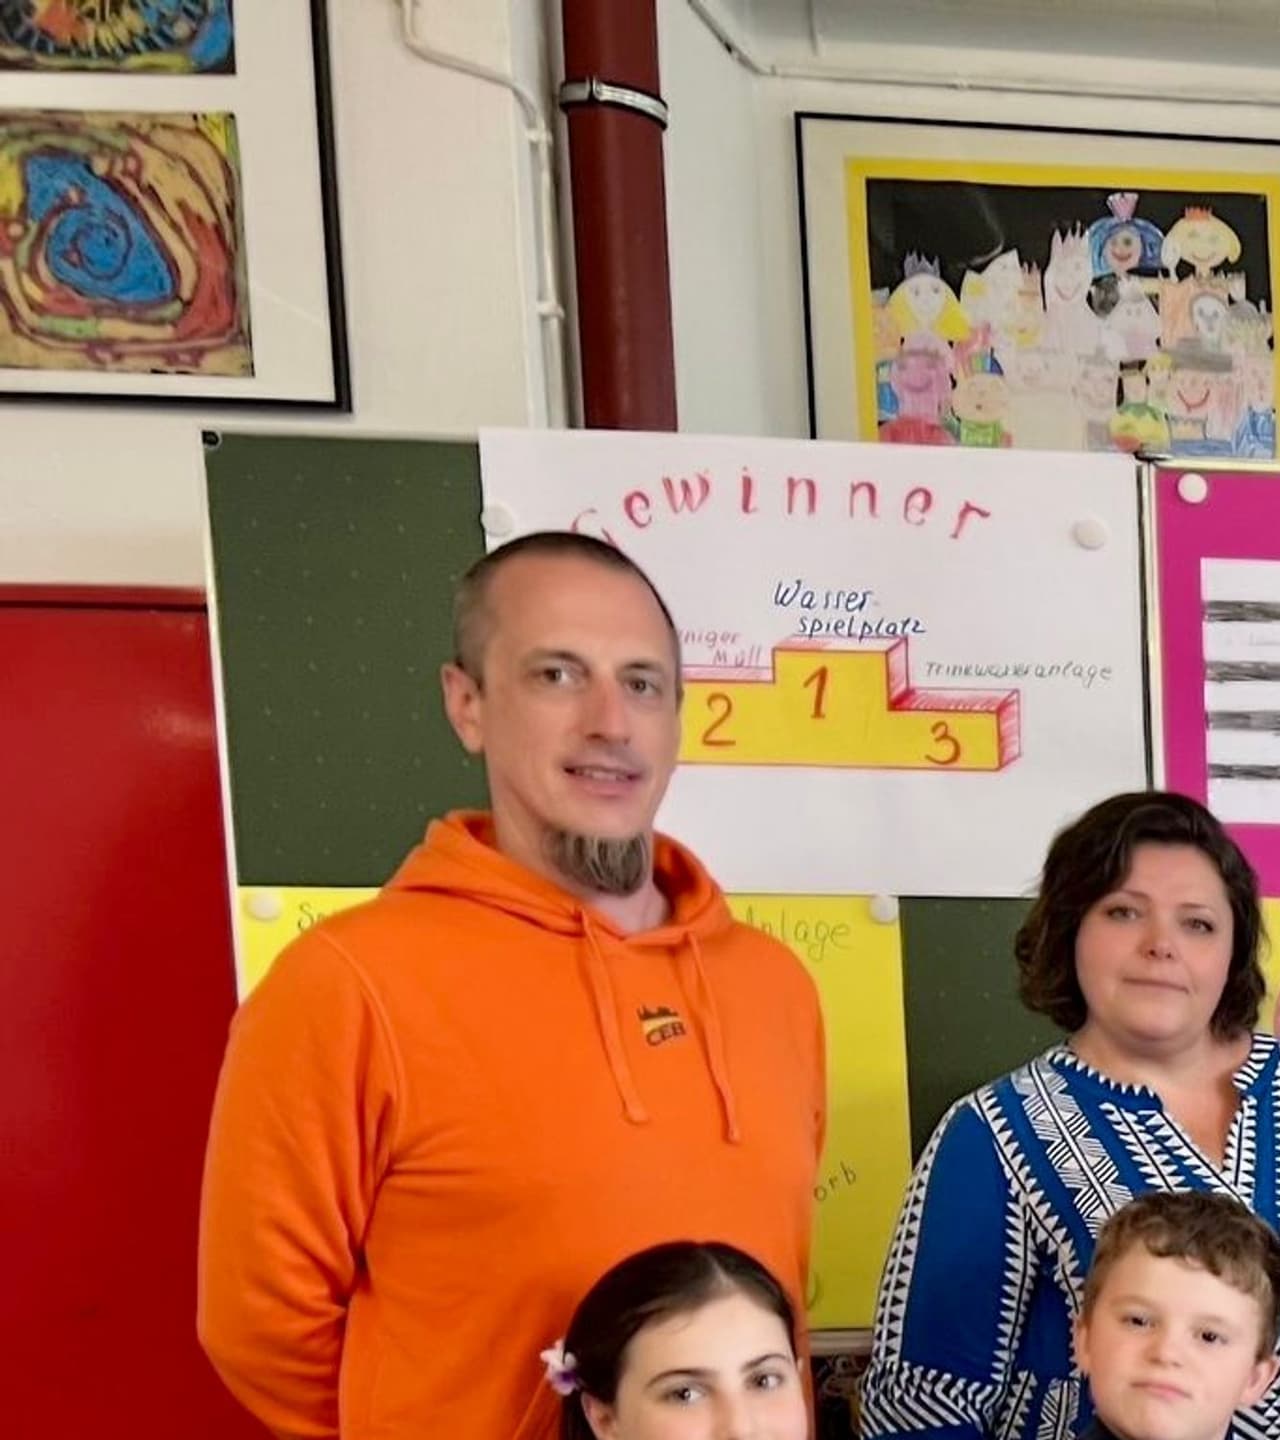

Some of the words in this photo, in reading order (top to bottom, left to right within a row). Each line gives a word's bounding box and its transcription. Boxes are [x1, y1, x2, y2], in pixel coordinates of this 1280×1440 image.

[699, 692, 737, 747] 2
[803, 666, 828, 720] 1
[925, 720, 962, 766] 3
